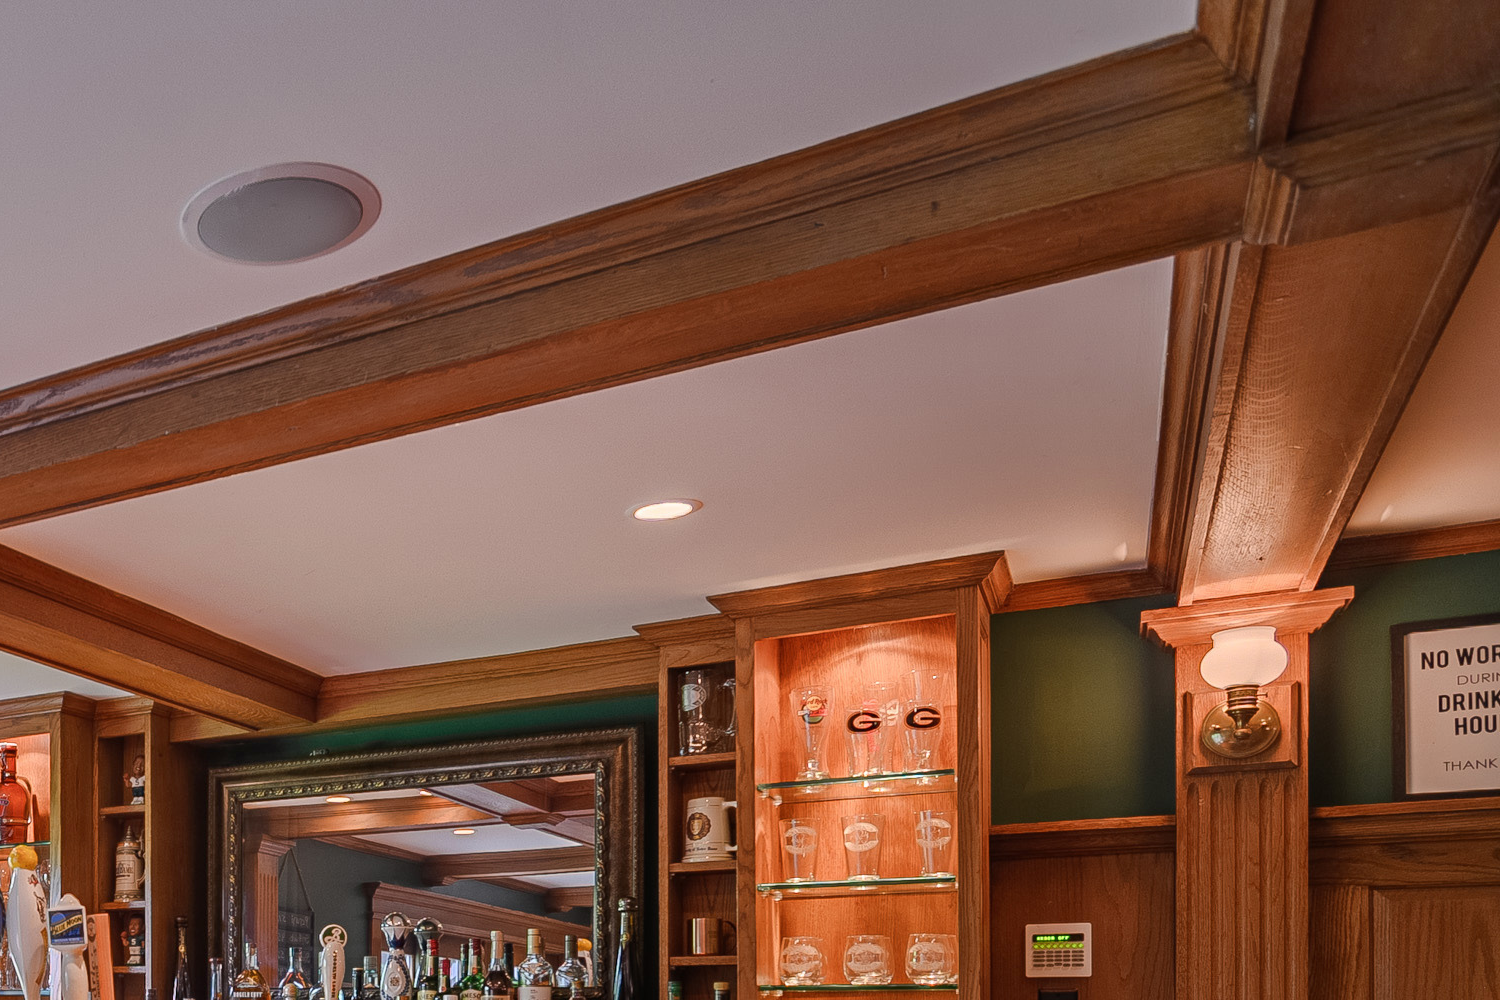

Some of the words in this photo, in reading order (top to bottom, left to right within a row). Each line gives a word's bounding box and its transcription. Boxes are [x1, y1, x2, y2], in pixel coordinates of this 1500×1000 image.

[1421, 650, 1449, 670] NO
[905, 706, 942, 730] G
[1443, 757, 1499, 772] THANK
[66, 916, 82, 927] MOON
